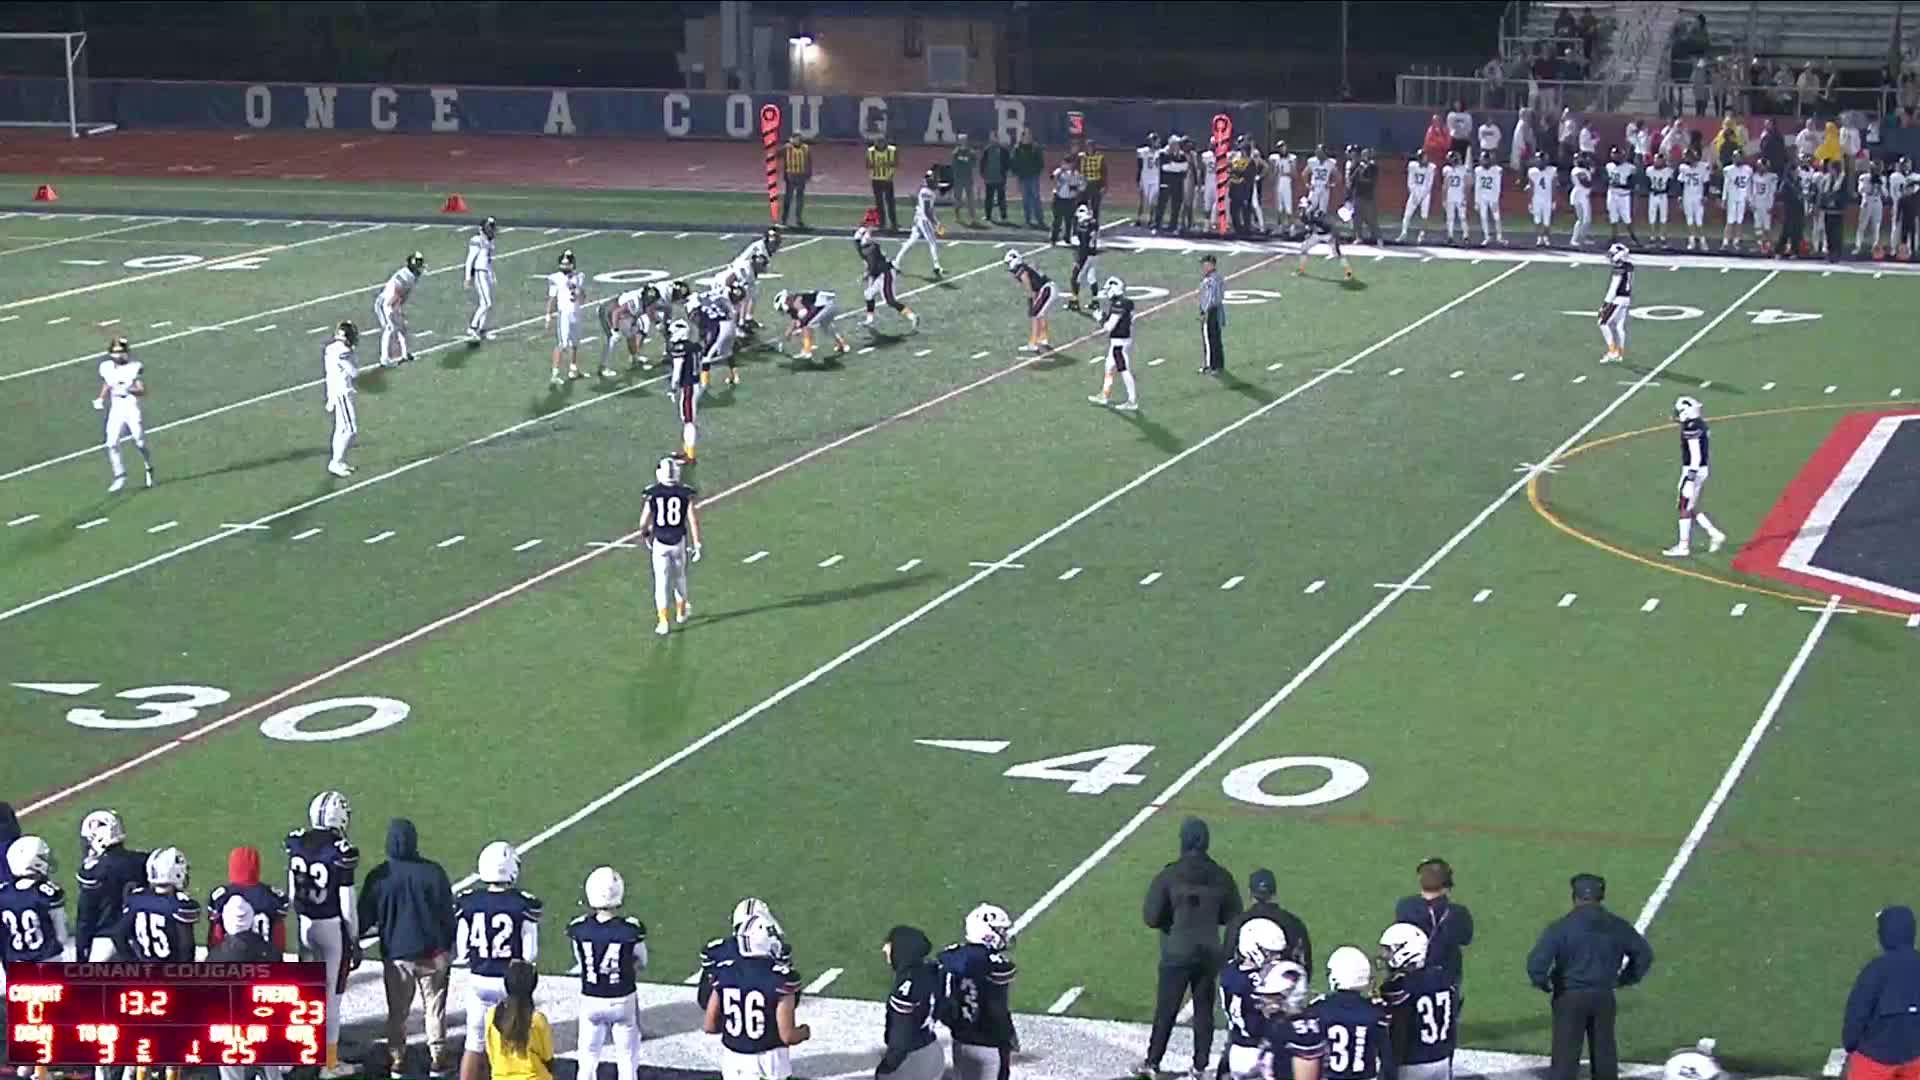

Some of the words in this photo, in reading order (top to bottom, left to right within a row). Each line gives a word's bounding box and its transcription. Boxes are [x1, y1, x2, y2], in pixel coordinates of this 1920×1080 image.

[245, 85, 459, 131] ONCE
[544, 90, 577, 135] A
[663, 93, 1027, 147] COUGAR
[656, 497, 681, 527] 18
[66, 685, 411, 741] 30
[1002, 744, 1370, 806] 40
[135, 911, 171, 959] 45
[469, 911, 514, 959] 42
[582, 941, 622, 984] 14
[722, 987, 766, 1040] 56
[1416, 991, 1451, 1044] 37
[1327, 1024, 1368, 1072] 31
